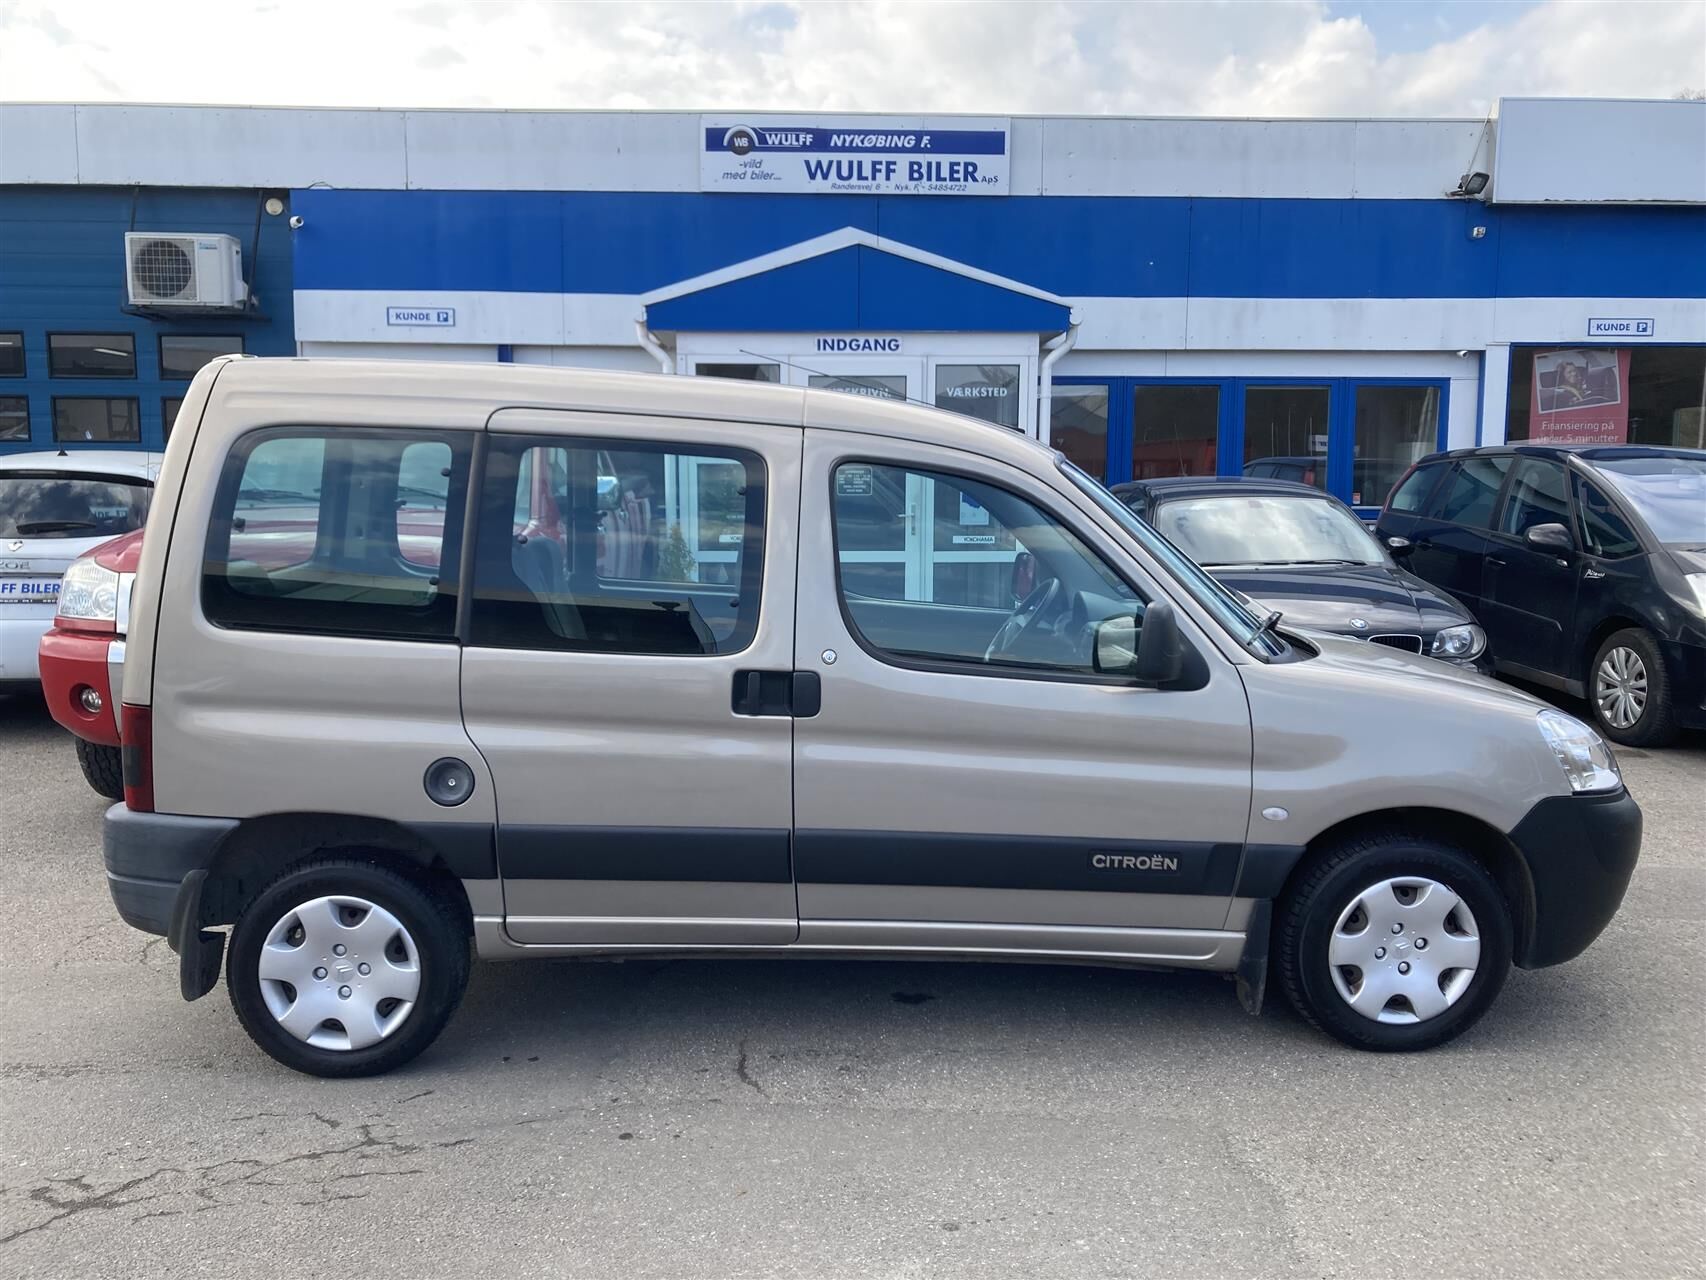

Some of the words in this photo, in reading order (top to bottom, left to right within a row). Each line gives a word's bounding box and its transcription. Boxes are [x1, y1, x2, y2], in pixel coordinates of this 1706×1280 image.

[765, 133, 814, 146] WULFF
[830, 134, 916, 148] NYKØBING
[722, 171, 746, 180] med
[804, 159, 897, 182] WULFF
[908, 160, 979, 183] BILER
[981, 174, 999, 185] ApS
[395, 312, 431, 321] KUNDE
[1596, 323, 1631, 331] KUNDE
[816, 338, 900, 352] INDGANG
[946, 387, 1008, 398] VÆRKSTED
[1542, 421, 1599, 432] Finansiering
[1601, 420, 1615, 431] på
[1567, 433, 1574, 443] 5
[1576, 434, 1619, 444] minutter
[21, 583, 61, 594] BILER
[1092, 853, 1178, 871] CITROËN
